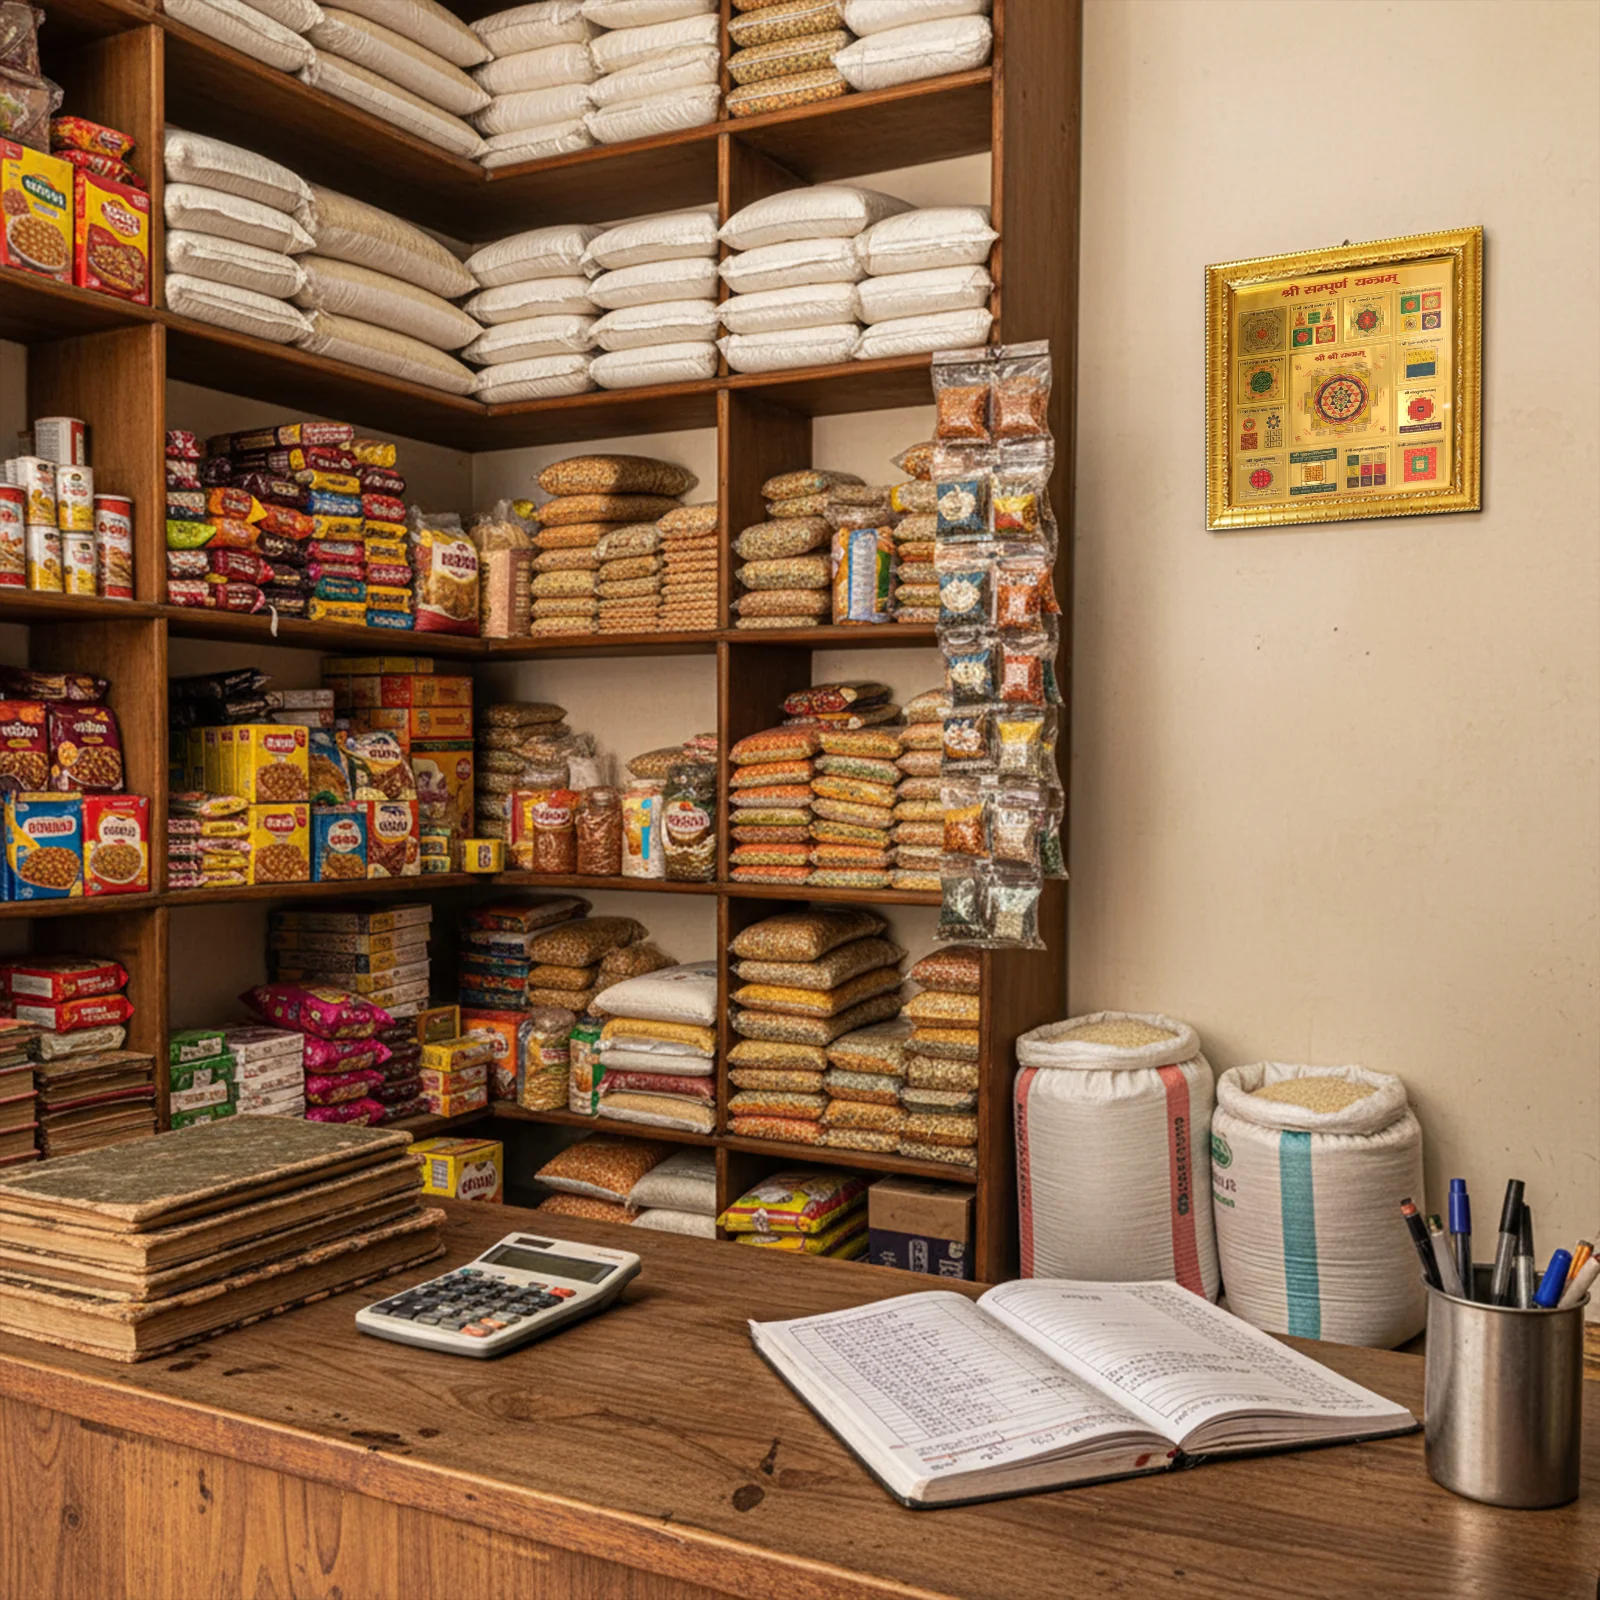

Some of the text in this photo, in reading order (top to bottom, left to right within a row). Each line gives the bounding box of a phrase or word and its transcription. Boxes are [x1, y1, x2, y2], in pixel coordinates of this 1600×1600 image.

[1281, 273, 1400, 298] श्री सम्पूर्ण यन्त्रम्
[1314, 353, 1325, 361] श्री
[1327, 352, 1338, 360] श्री
